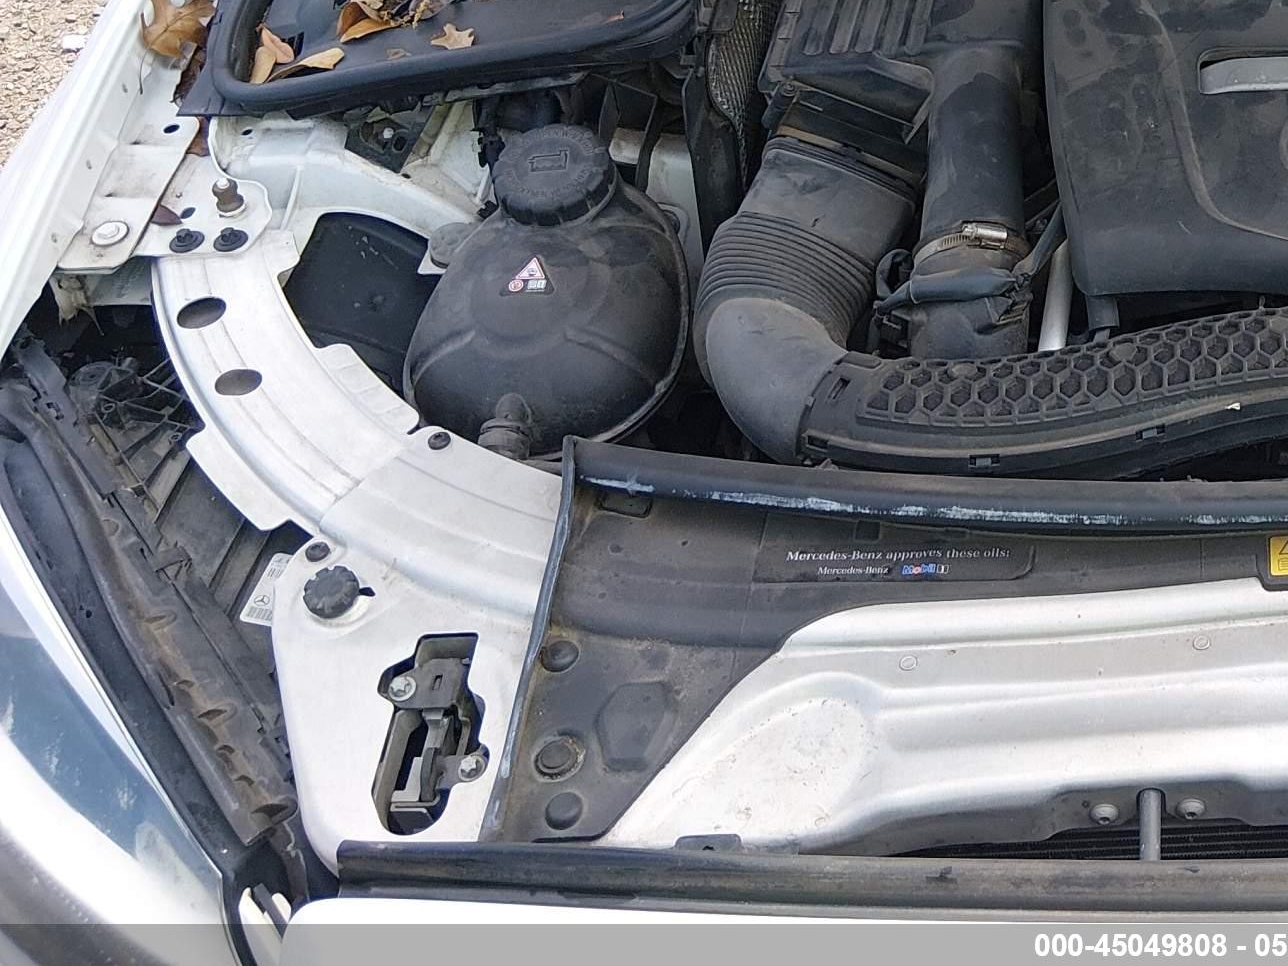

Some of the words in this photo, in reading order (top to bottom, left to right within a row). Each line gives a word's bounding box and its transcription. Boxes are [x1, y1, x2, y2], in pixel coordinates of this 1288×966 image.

[786, 551, 882, 561] Mercedes-Benz
[885, 548, 942, 561] approves
[946, 549, 980, 558] these
[984, 548, 1010, 558] oils:
[817, 566, 889, 575] Mercedes-Benz
[902, 564, 936, 575] Mobil
